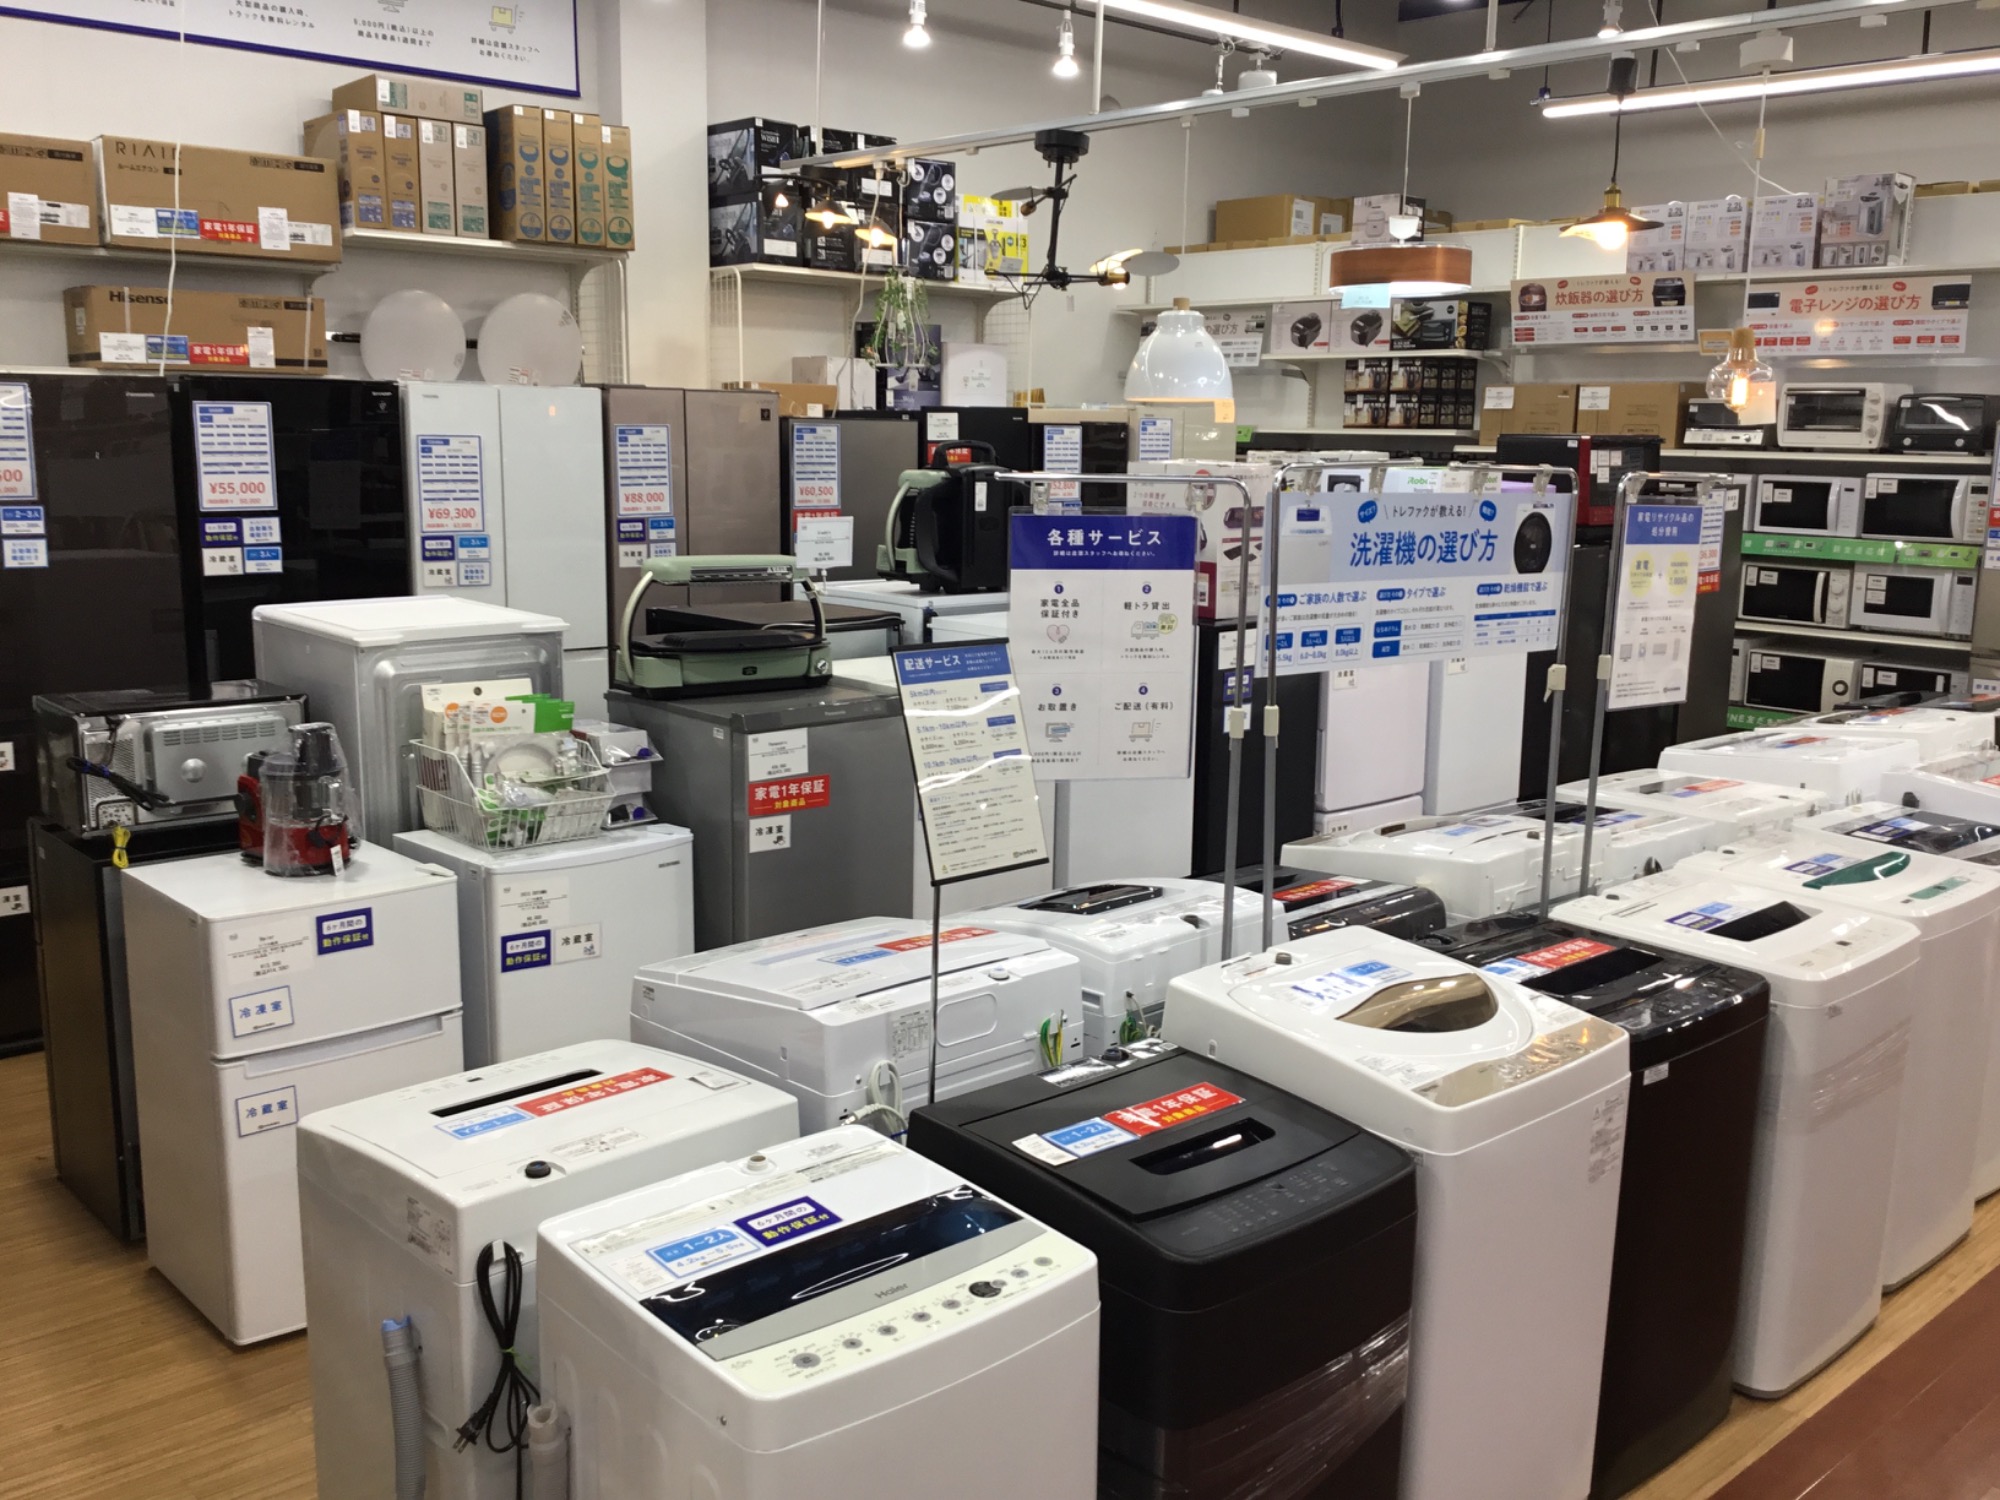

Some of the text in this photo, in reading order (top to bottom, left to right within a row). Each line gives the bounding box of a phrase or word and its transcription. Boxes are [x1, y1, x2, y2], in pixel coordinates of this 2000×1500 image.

[1555, 288, 1645, 306] 炊飯器の選び方
[1789, 294, 1922, 314] 電子レンジの選び方
[209, 482, 266, 496] ¥55,000
[624, 492, 665, 504] ¥88,000
[428, 507, 476, 520] ¥69,300
[1047, 529, 1162, 547] 各種サービス
[1349, 528, 1499, 568] 洗濯機の選び方
[1299, 590, 1368, 605] ご家族の人数で選ぶ
[1407, 586, 1447, 600] タイプで選ぶ
[1040, 598, 1080, 608] 家電全品
[1124, 601, 1170, 611] 軽トラ貸出
[1040, 610, 1080, 618] 保証付き
[903, 655, 961, 671] 配送サービス
[1037, 703, 1077, 712] お取置き
[754, 778, 825, 801] 家電1年保証
[774, 797, 806, 810] 対象商品
[755, 824, 784, 837] 冷凍室
[322, 932, 369, 948] 動作保証付
[561, 932, 594, 946] 冷蔵室
[506, 953, 547, 966] 動作保証付
[239, 1000, 283, 1019] 冷凍室
[246, 1099, 288, 1118] 冷蔵室
[756, 1205, 808, 1227] 6ヶ月間の
[761, 1213, 831, 1240] 動作保証付
[874, 1282, 909, 1299] Haier
